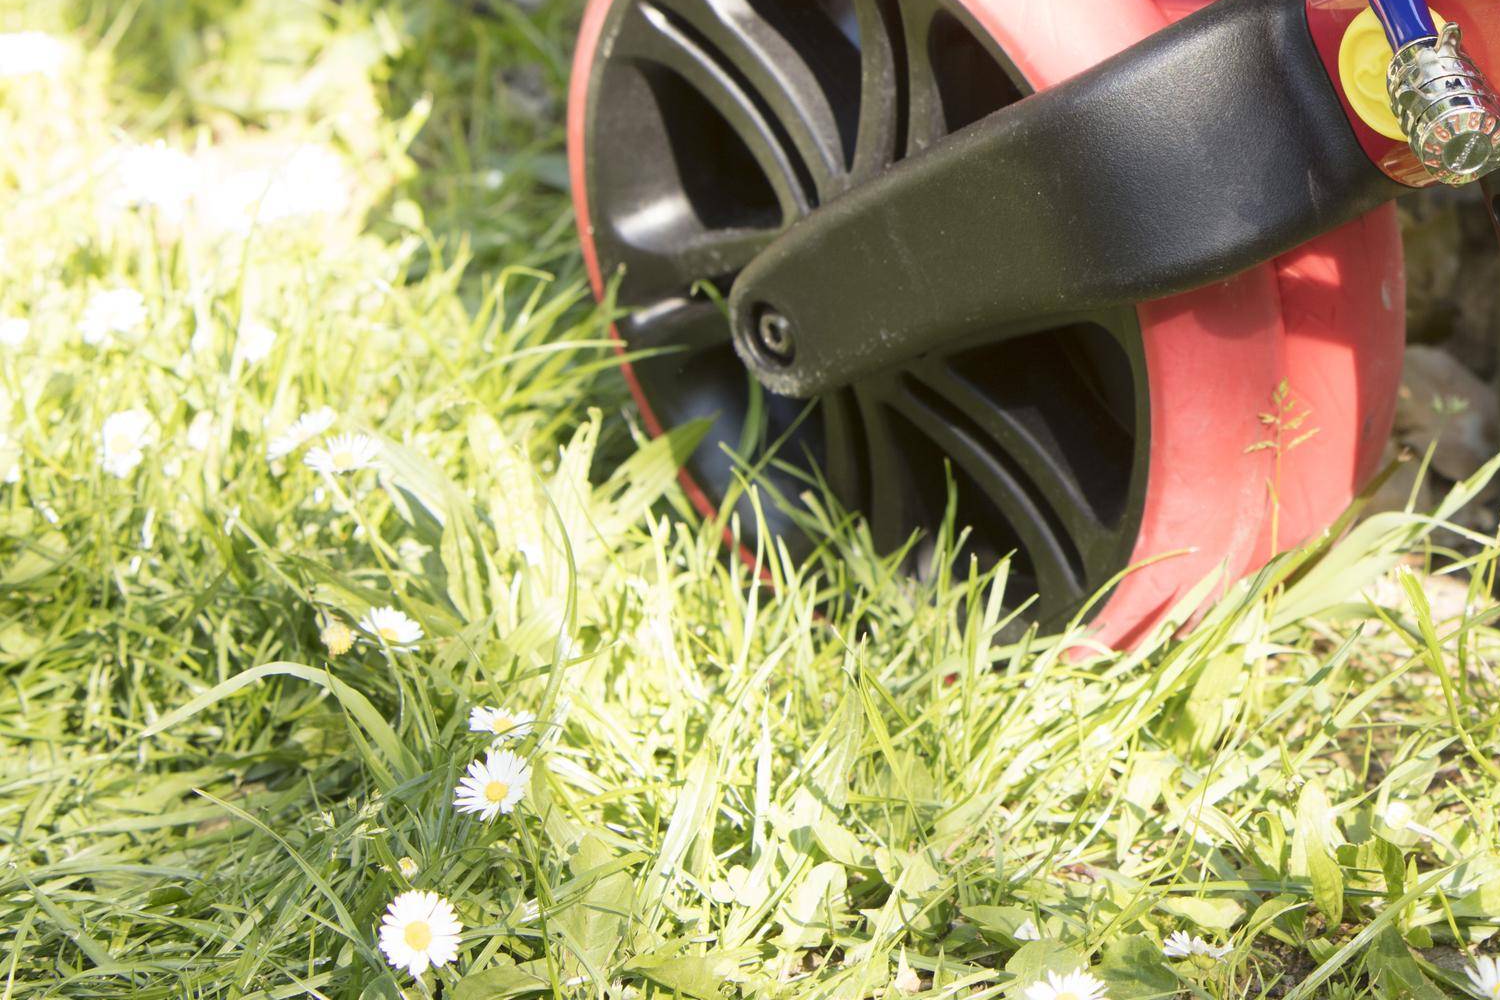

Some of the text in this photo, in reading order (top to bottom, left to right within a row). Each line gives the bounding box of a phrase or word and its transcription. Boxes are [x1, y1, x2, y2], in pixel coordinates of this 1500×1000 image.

[1434, 123, 1451, 142] 6
[1447, 113, 1461, 135] 7
[1467, 110, 1482, 131] 8
[1481, 116, 1496, 135] 9
